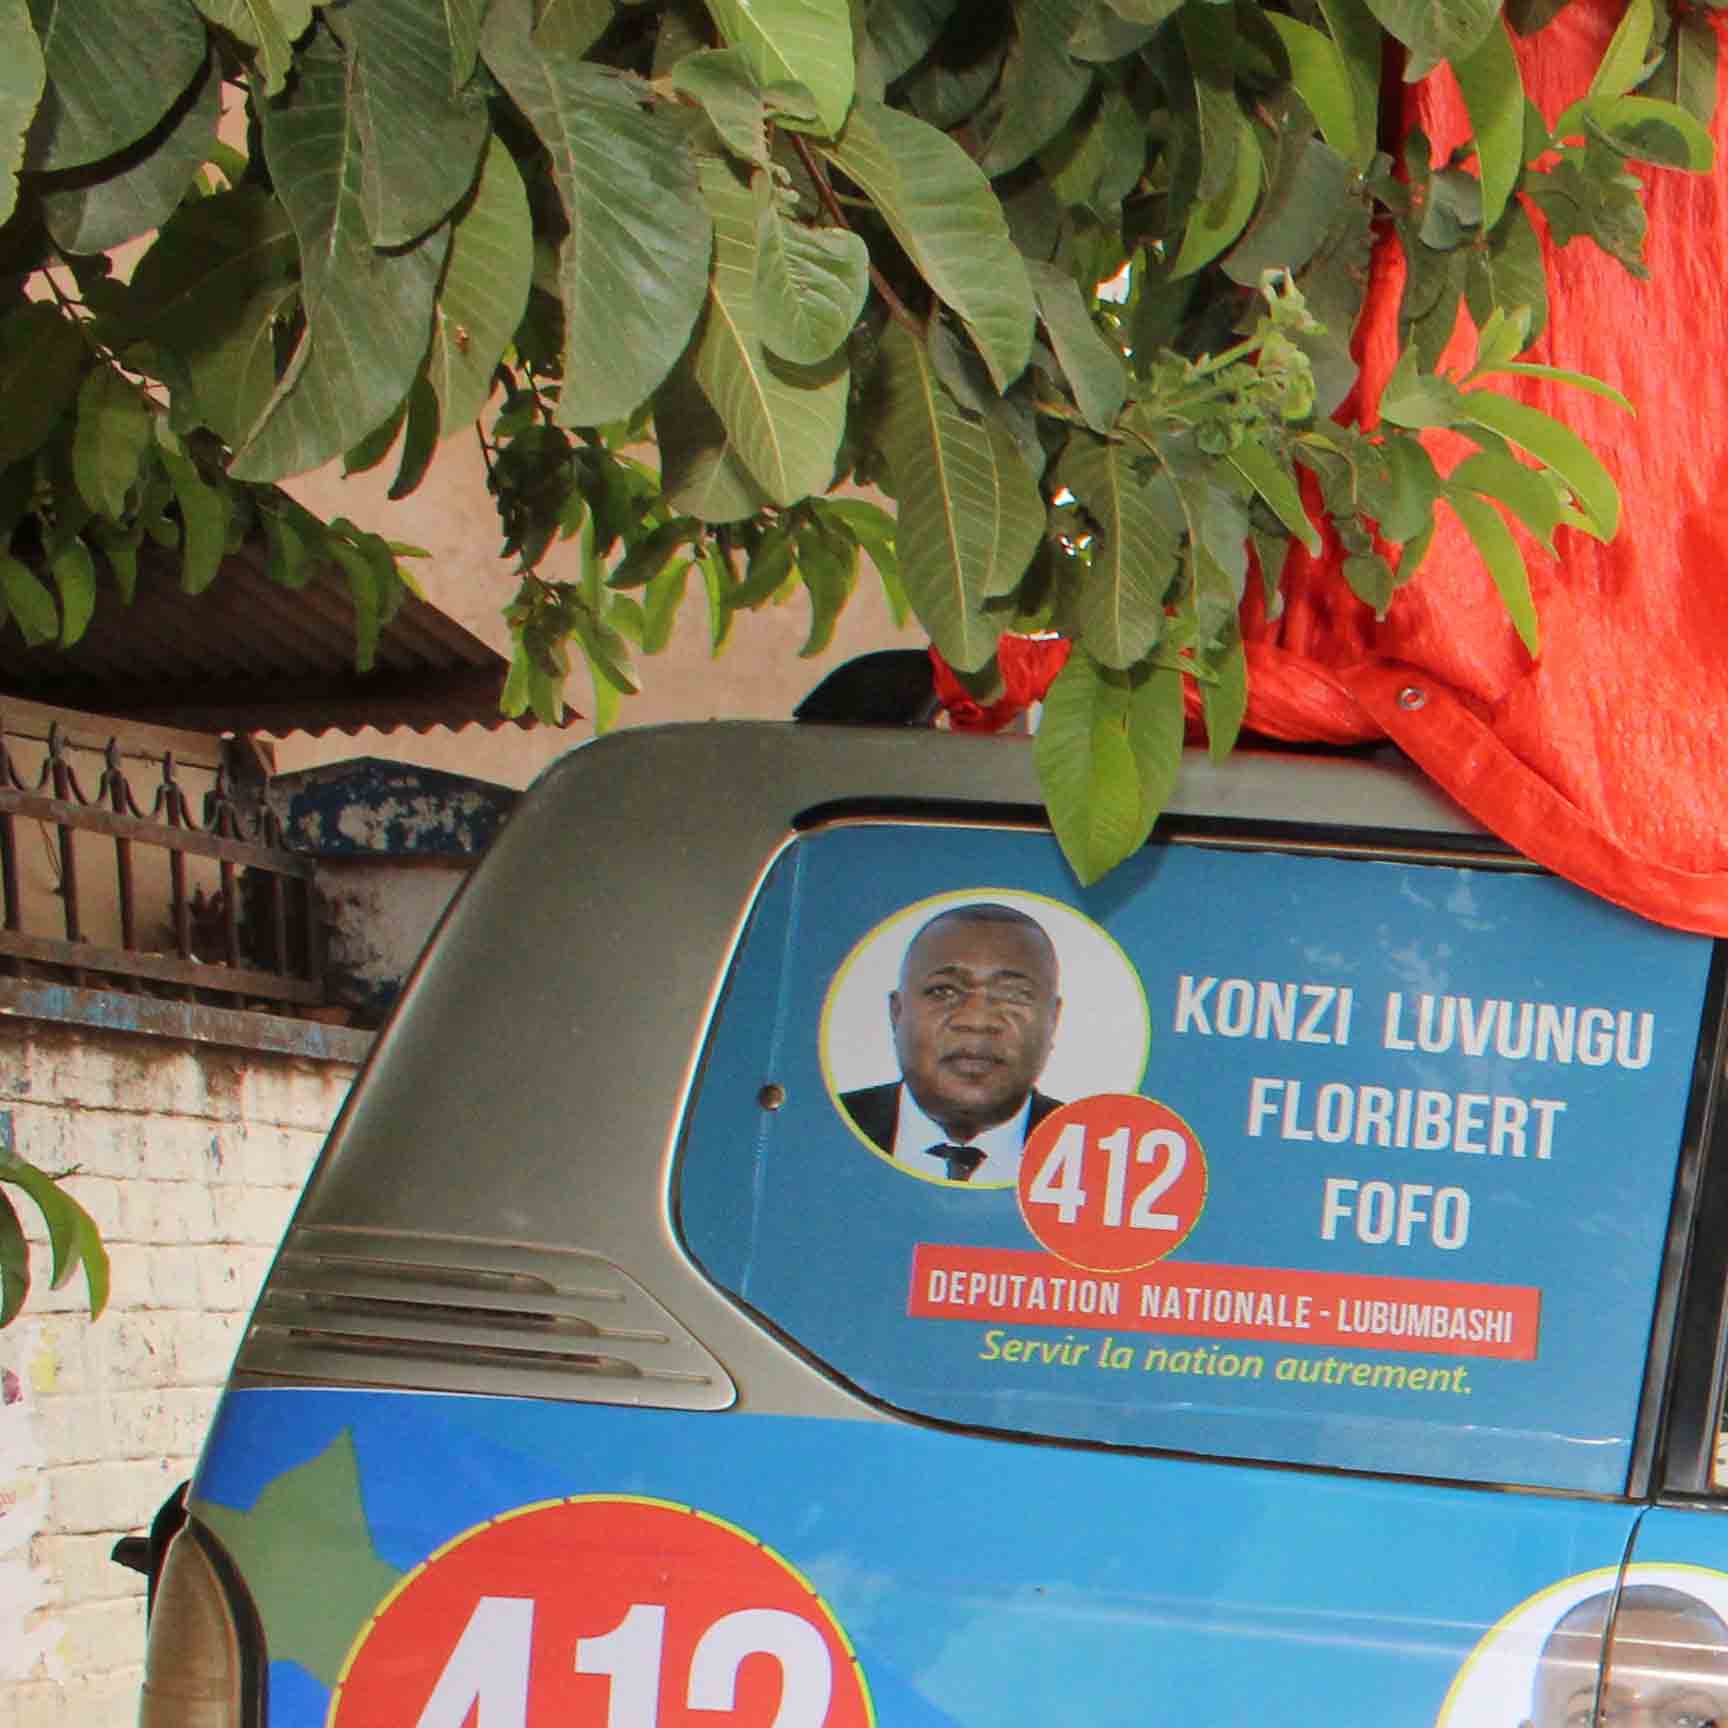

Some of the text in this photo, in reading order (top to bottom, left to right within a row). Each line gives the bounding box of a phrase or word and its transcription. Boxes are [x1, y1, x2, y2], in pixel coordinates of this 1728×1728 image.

[1174, 974, 1656, 1069] KONZI LUVUNGU
[1247, 1076, 1567, 1159] FLORIBERT
[1028, 1122, 1190, 1232] 412
[1321, 1178, 1470, 1251] FOFO
[927, 1269, 1120, 1317] DEPUTATION
[1141, 1286, 1311, 1329] NATIONALE
[1337, 1299, 1513, 1344] LUBUMBASHI
[980, 1329, 1473, 1395] Servir la nation autrement.
